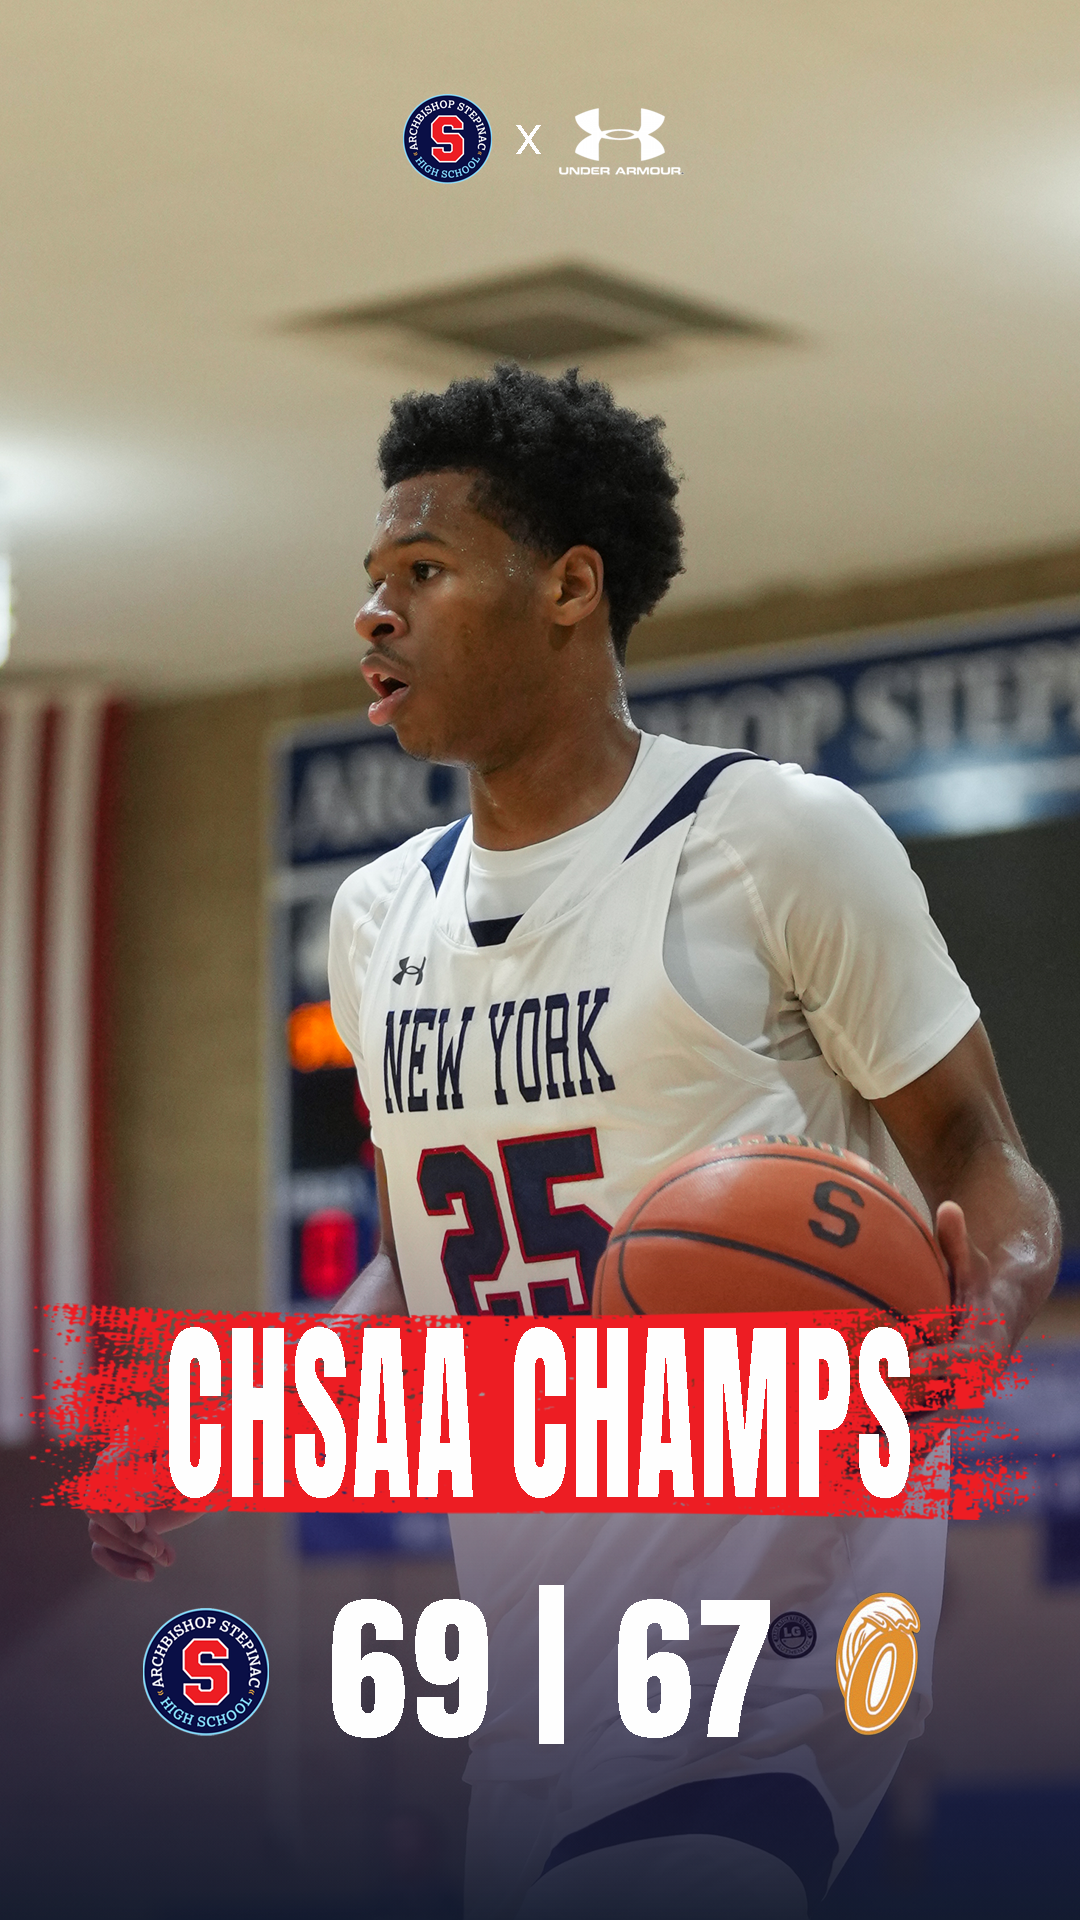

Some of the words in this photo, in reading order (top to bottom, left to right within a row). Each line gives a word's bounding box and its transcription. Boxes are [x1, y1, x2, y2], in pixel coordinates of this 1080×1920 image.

[383, 1006, 475, 1114] NEW
[488, 987, 616, 1106] YORK
[416, 1126, 614, 1317] 25
[809, 1180, 865, 1248] S
[783, 1626, 802, 1638] LG
